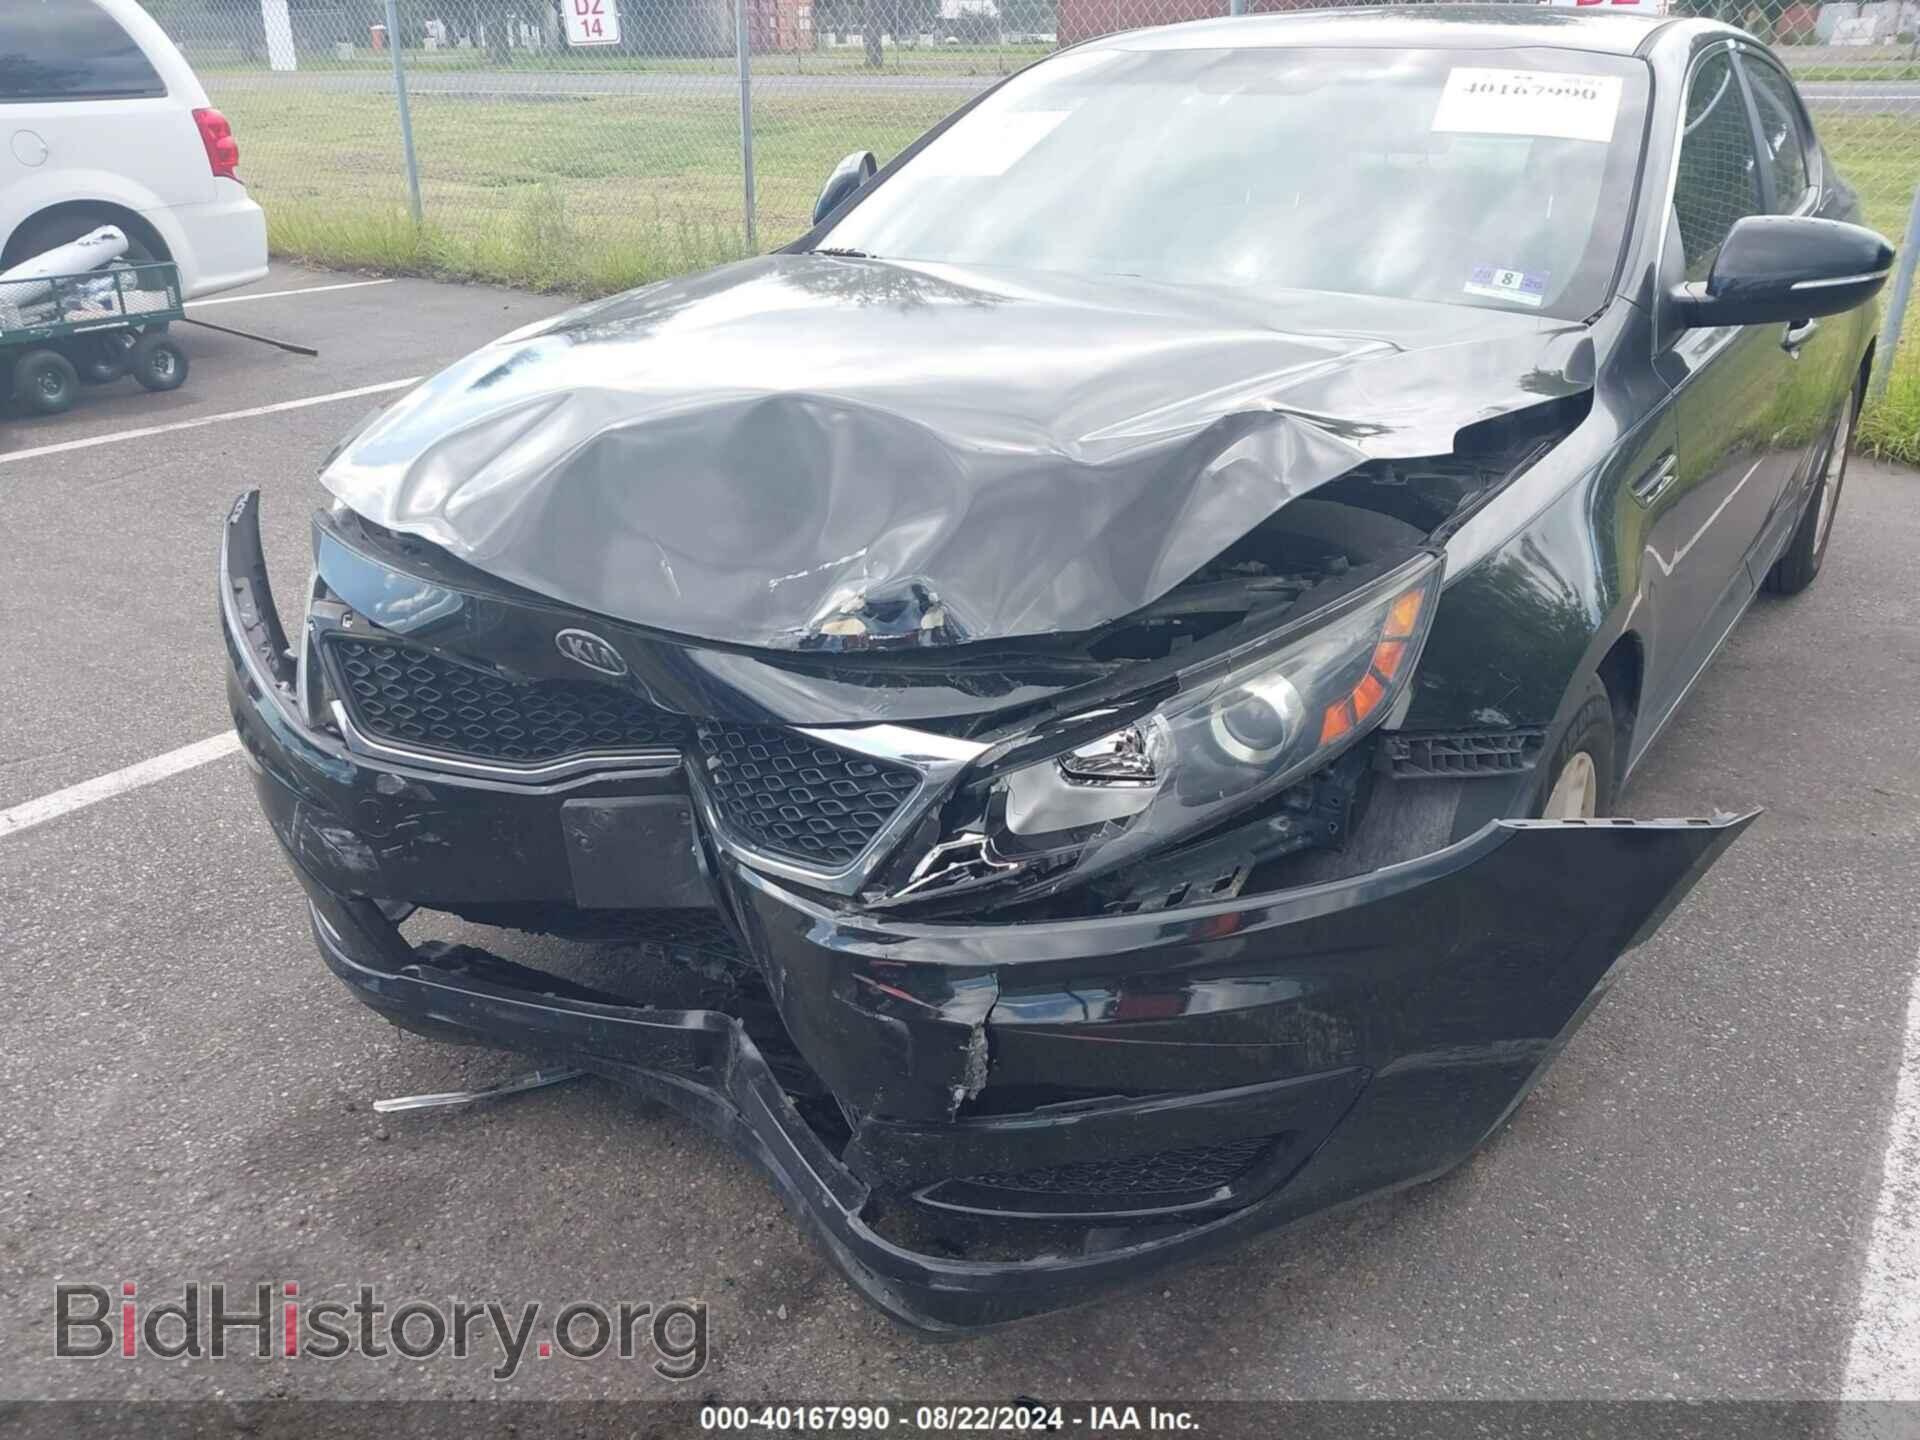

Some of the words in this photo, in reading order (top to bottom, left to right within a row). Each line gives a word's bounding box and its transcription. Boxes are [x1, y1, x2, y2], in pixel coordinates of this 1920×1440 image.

[581, 18, 603, 37] 14
[1501, 272, 1514, 286] 8
[566, 635, 621, 671] KIA
